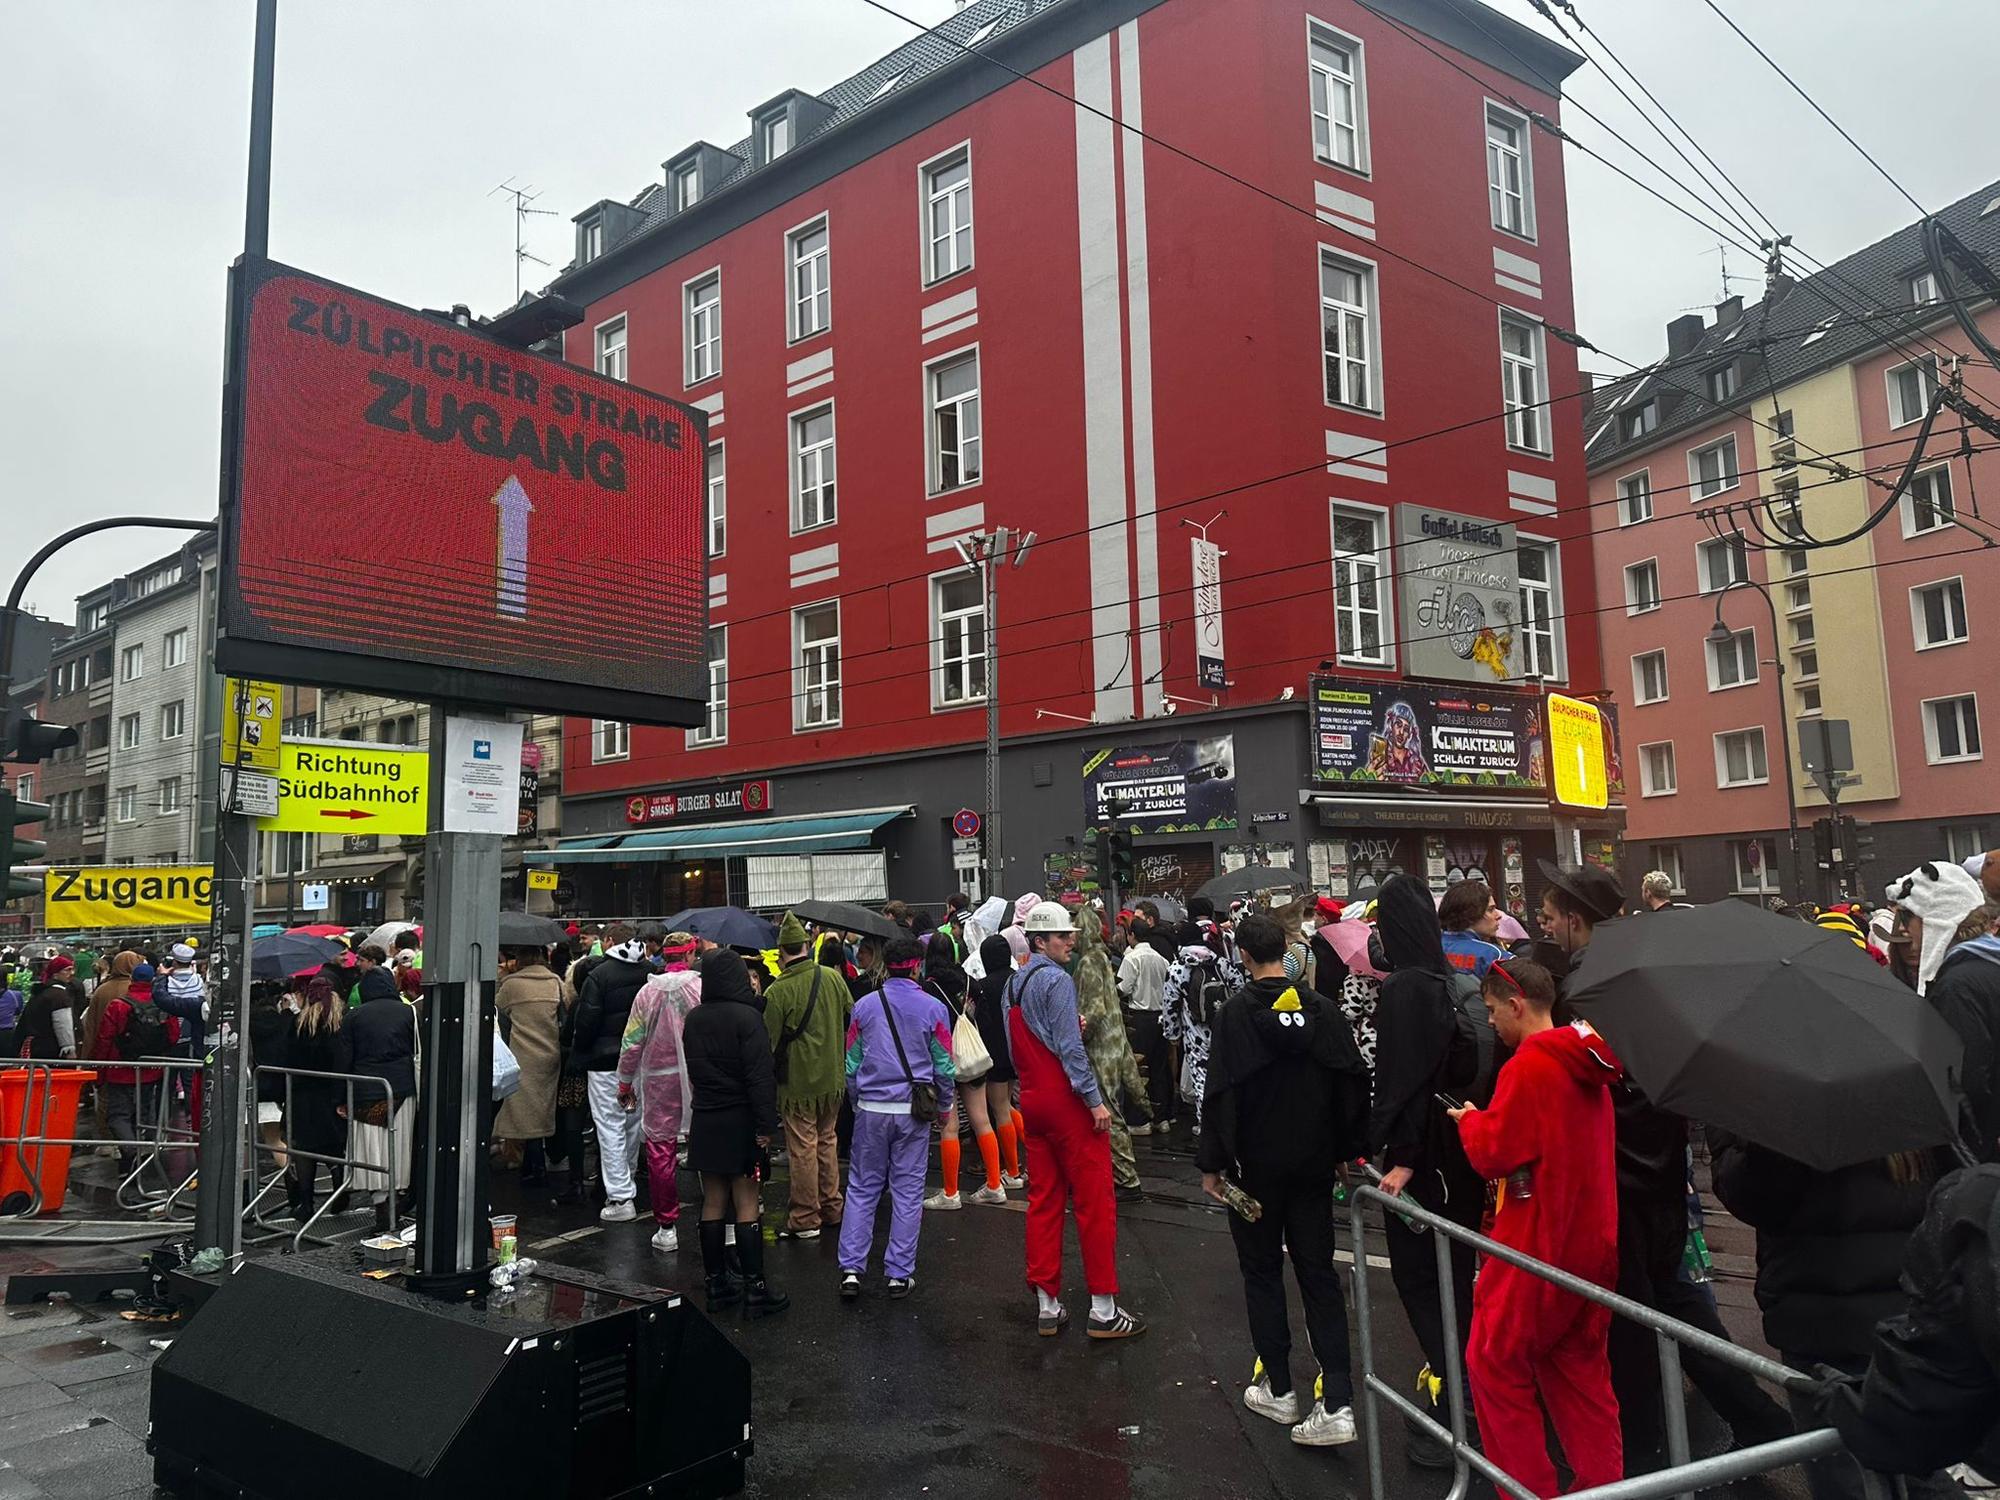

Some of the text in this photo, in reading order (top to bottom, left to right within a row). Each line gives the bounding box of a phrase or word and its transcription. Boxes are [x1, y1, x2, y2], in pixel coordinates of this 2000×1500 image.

[287, 296, 538, 405] ZÜLPICHER
[362, 369, 628, 493] ZUGANG
[1439, 543, 1486, 566] Theater
[1456, 565, 1511, 589] Filmdose
[296, 752, 401, 782] Richtung
[1433, 753, 1519, 767] SCHLÄGT ZURÜCK
[280, 778, 420, 804] Südbahnhof
[650, 790, 742, 817] SMASH BURGER SALAT
[1144, 798, 1186, 809] ZURÜCK
[51, 870, 213, 909] Zugang
[534, 874, 552, 884] SP 9
